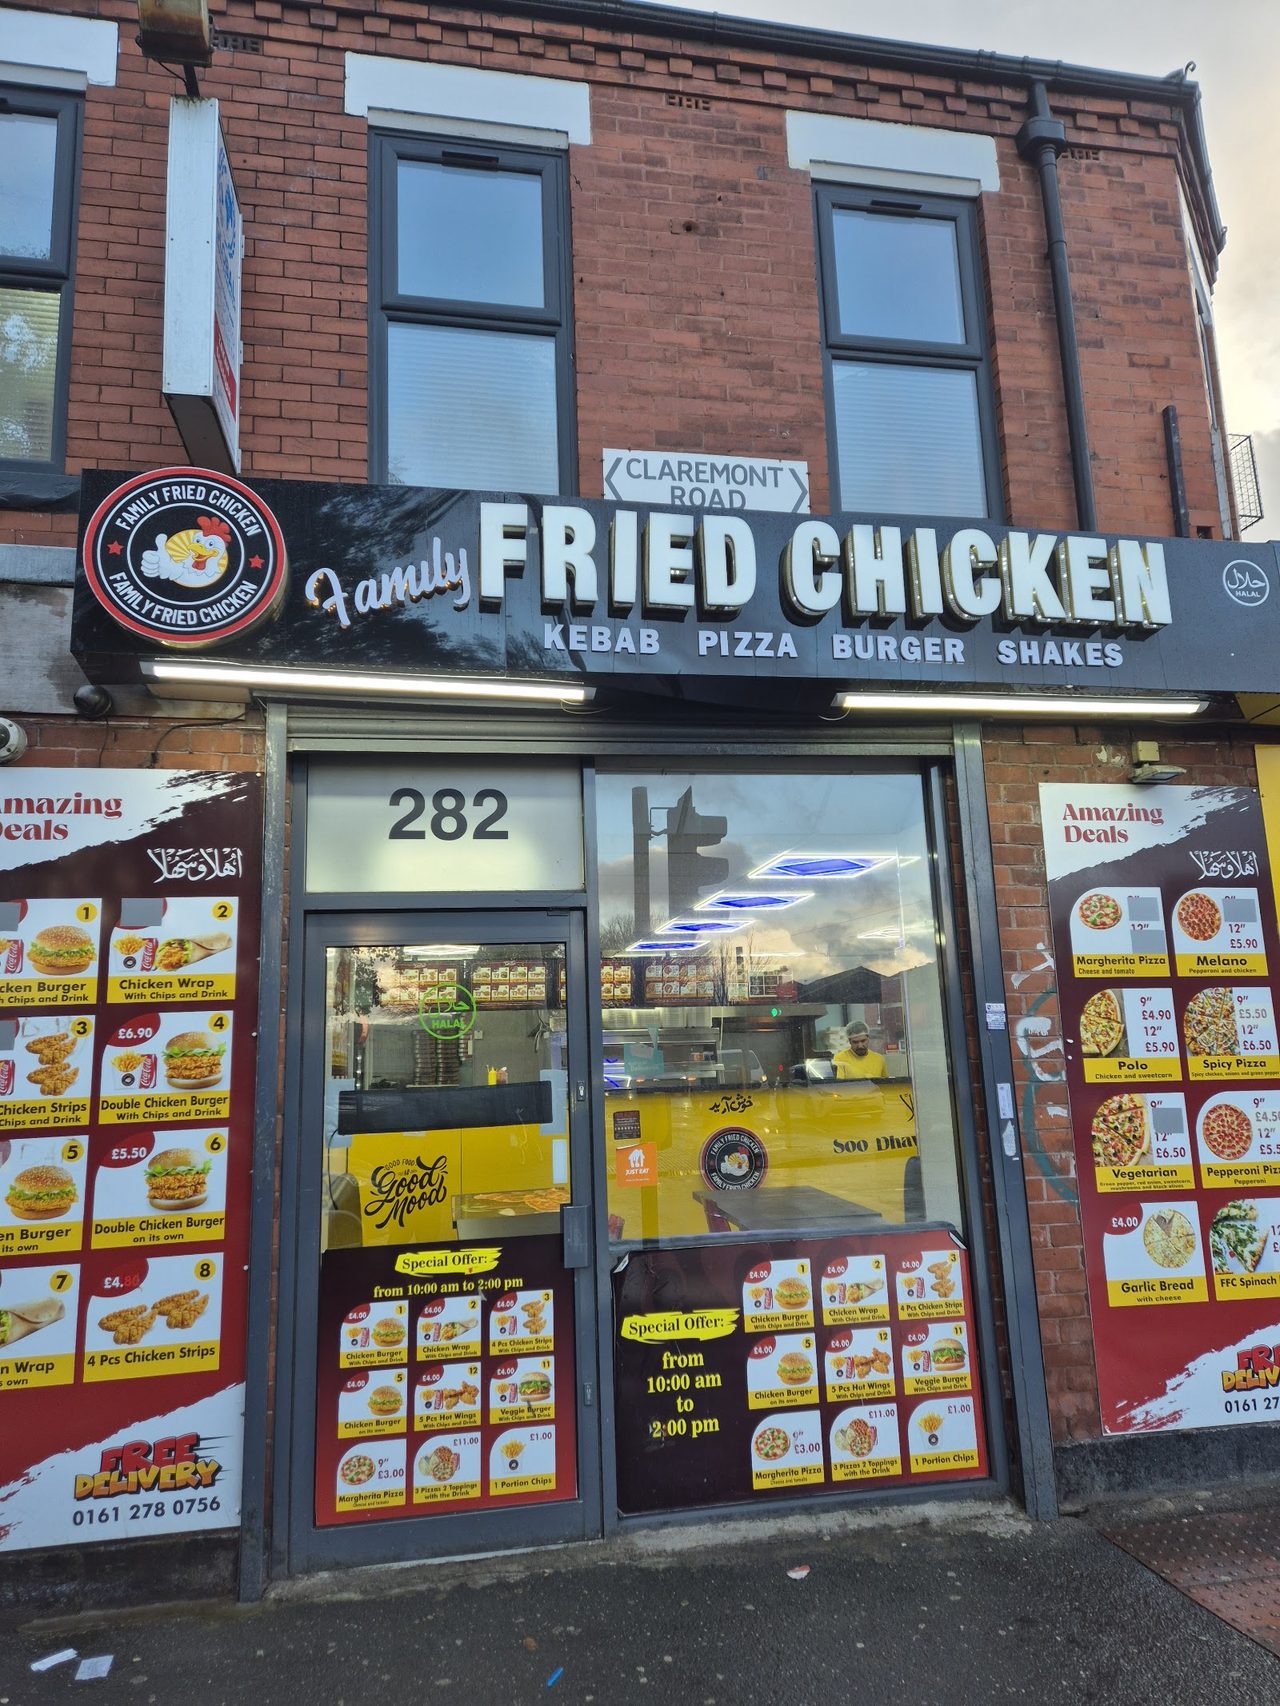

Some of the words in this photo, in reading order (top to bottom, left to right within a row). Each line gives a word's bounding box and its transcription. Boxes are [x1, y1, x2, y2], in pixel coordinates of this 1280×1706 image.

[626, 457, 783, 488] CLAREMONT
[670, 486, 746, 509] ROAD
[115, 490, 161, 531] FAMILY
[162, 485, 206, 502] FRIED
[209, 489, 262, 537] CHICKEN
[305, 536, 471, 627] Family
[479, 502, 756, 612] FRIED
[781, 520, 1172, 630] CHICKEN
[1228, 568, 1265, 589] حلال
[109, 572, 152, 614] FAMILY
[152, 605, 198, 625] FRIED
[200, 580, 258, 623] CHICKEN
[1235, 590, 1261, 598] HALAL
[544, 623, 660, 655] KEBAB
[698, 629, 799, 658] PIZZA
[832, 633, 966, 664] BURGER
[996, 640, 1124, 667] SHAKES
[388, 787, 508, 841] 282
[1063, 803, 1165, 826] Amazing
[1064, 825, 1129, 843] Deals
[82, 906, 90, 919] 1
[217, 905, 228, 918] 2
[1231, 939, 1258, 949] £5.90
[1077, 956, 1136, 968] Margherita
[1139, 955, 1166, 965] Pizza
[1196, 955, 1247, 966] Melano
[37, 982, 86, 994] Burger
[119, 979, 173, 990] Chicken
[177, 977, 215, 990] Wrap
[8, 996, 35, 1005] Chips
[61, 994, 89, 1003] Drink
[124, 991, 146, 1000] With
[150, 991, 176, 1001] Chips
[179, 991, 198, 999] and
[201, 990, 228, 998] Drink
[1142, 1010, 1171, 1020] £4.90
[1239, 1008, 1267, 1019] £5.50
[76, 1021, 88, 1034] 3
[213, 1016, 225, 1030] 4
[432, 1019, 465, 1029] HALAL
[117, 1027, 153, 1039] £6.90
[1145, 1042, 1175, 1053] £5.90
[1243, 1040, 1271, 1050] £6.50
[1118, 1060, 1148, 1070] Polo
[1203, 1060, 1232, 1070] Spicy
[1236, 1059, 1266, 1068] Pizza
[50, 1102, 87, 1114] Strips
[101, 1098, 141, 1111] Double
[144, 1096, 188, 1109] Chicken
[190, 1094, 229, 1108] Burger
[29, 1117, 50, 1126] and
[53, 1115, 81, 1124] Drink
[116, 1111, 139, 1121] With
[142, 1110, 170, 1121] Chips
[172, 1109, 192, 1118] and
[195, 1107, 222, 1117] Drink
[210, 1137, 221, 1151] 6
[833, 1138, 868, 1153] Soo
[67, 1145, 78, 1159] 5
[112, 1147, 147, 1160] £5.50
[1156, 1147, 1186, 1158] £6.50
[1112, 1168, 1178, 1181] Vegetarian
[1207, 1165, 1260, 1178] Pepperoni
[364, 1155, 447, 1216] Good
[375, 1175, 447, 1229] Mood
[94, 1221, 135, 1235] Double
[139, 1219, 182, 1231] Chicken
[185, 1216, 224, 1231] Burger
[1111, 1217, 1139, 1228] £4.00
[20, 1227, 71, 1241] Burger
[133, 1235, 146, 1243] on
[149, 1234, 161, 1243] its
[163, 1233, 184, 1241] own
[17, 1244, 39, 1252] own
[402, 1257, 448, 1272] Special
[452, 1254, 487, 1266] Offer:
[200, 1263, 211, 1277] 8
[56, 1274, 68, 1289] 7
[1121, 1281, 1156, 1294] Garlic
[1160, 1279, 1194, 1291] Bread
[1220, 1278, 1237, 1288] FFC
[1240, 1276, 1277, 1288] Spinach
[373, 1286, 403, 1298] from
[407, 1284, 437, 1296] 10:00
[440, 1284, 459, 1293] am
[462, 1282, 475, 1292] to
[477, 1279, 501, 1290] 2:00
[504, 1279, 523, 1290] pm
[1136, 1295, 1154, 1303] with
[782, 1314, 808, 1322] Burger
[829, 1309, 857, 1317] Chicken
[859, 1307, 878, 1315] Wrap
[629, 1320, 680, 1337] Special
[685, 1316, 724, 1330] Offer:
[87, 1355, 96, 1367] 4
[100, 1355, 120, 1366] Pcs
[124, 1350, 175, 1364] Chicken
[179, 1346, 216, 1360] Strips
[377, 1350, 402, 1358] Burger
[662, 1351, 704, 1370] from
[15, 1361, 55, 1375] Wrap
[6, 1378, 28, 1386] own
[647, 1374, 690, 1393] 10:00
[695, 1373, 722, 1389] am
[915, 1378, 940, 1387] Veggie
[943, 1376, 967, 1384] Burger
[755, 1391, 784, 1400] Chicken
[787, 1388, 813, 1397] Burger
[677, 1395, 694, 1413] to
[948, 1404, 971, 1414] £1.00
[1225, 1399, 1257, 1413] 0161
[1264, 1396, 1280, 1409] 27
[869, 1409, 895, 1418] £11.00
[652, 1418, 687, 1438] 2:00
[692, 1418, 719, 1438] pm
[453, 1437, 479, 1446] £11.00
[530, 1431, 552, 1441] £1.00
[100, 1432, 200, 1475] FREE
[794, 1443, 820, 1454] £3.00
[922, 1456, 951, 1465] Portion
[953, 1453, 975, 1462] Chips
[378, 1468, 404, 1479] £3.00
[756, 1469, 799, 1480] Margherita
[801, 1466, 822, 1475] Pizza
[74, 1460, 223, 1500] DELIVERY
[501, 1480, 528, 1488] Portion
[532, 1477, 552, 1485] Chips
[339, 1492, 381, 1503] Margherita
[384, 1490, 404, 1498] Pizza
[73, 1506, 120, 1526] 0161
[129, 1502, 165, 1520] 278
[173, 1496, 221, 1515] 0756
